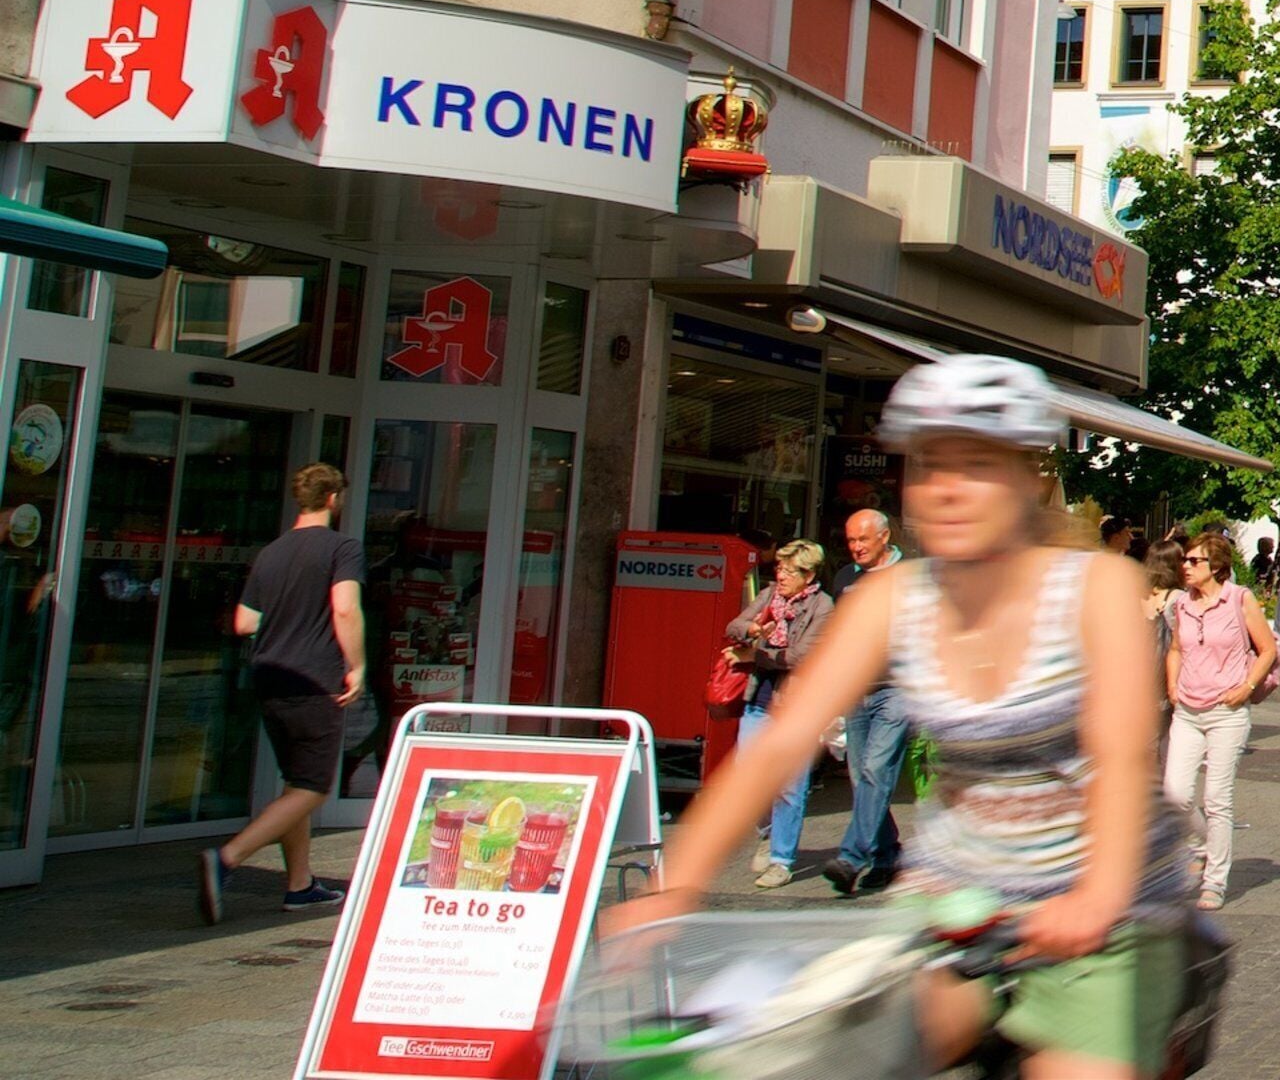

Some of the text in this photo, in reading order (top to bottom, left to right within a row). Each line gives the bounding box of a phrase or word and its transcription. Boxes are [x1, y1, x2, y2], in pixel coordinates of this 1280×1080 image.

[377, 76, 655, 163] KRONEN
[992, 193, 1093, 287] NORDSEE
[845, 455, 887, 467] SUSHI
[619, 560, 695, 578] NORDSEE
[398, 668, 459, 682] Antistax
[424, 895, 525, 922] Tea to go
[422, 921, 517, 934] Tee zum Mitnehmen
[383, 1039, 490, 1058] Tee Gschwendner
